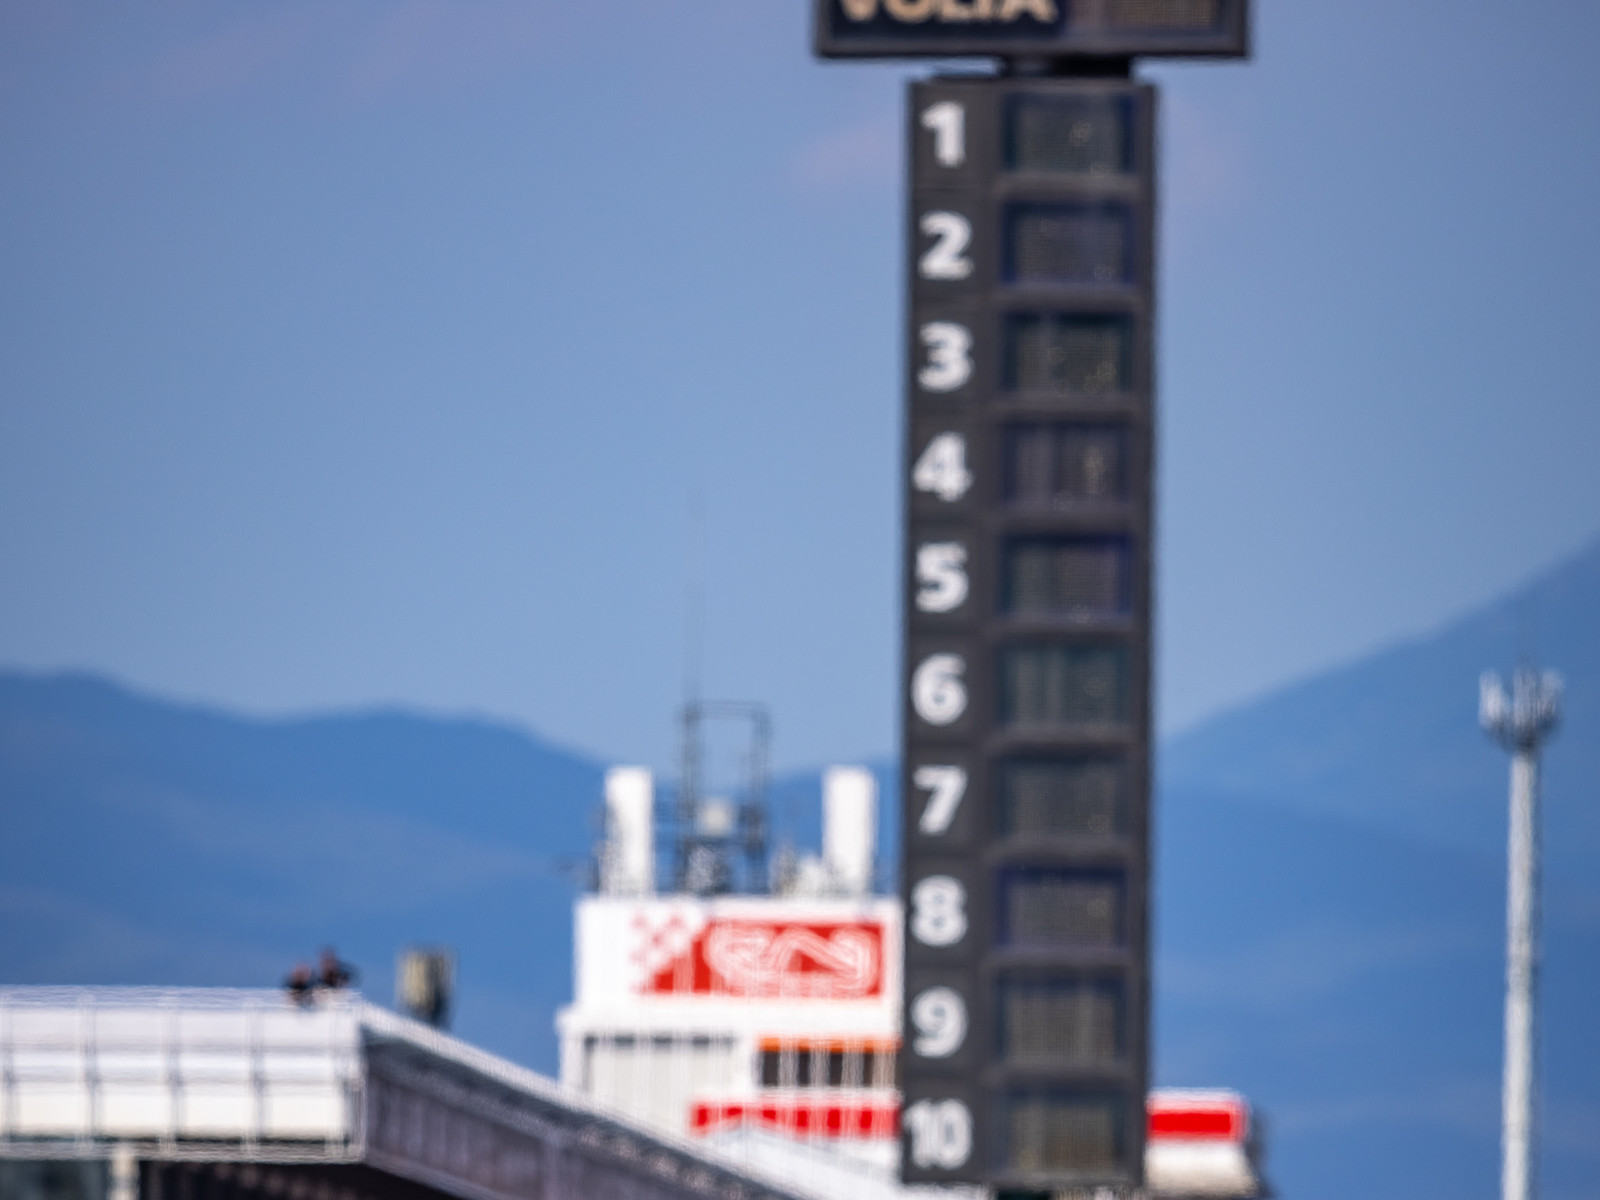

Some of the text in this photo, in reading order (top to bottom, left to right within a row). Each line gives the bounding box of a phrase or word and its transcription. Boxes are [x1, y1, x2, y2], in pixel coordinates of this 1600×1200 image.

[923, 102, 965, 166] 1
[921, 212, 971, 279] 2
[920, 322, 972, 391] 3
[914, 433, 971, 502] 4
[917, 543, 969, 614] 5
[912, 654, 967, 726] 6
[915, 765, 968, 835] 7
[912, 875, 968, 947] 8
[912, 987, 968, 1058] 9
[905, 1099, 973, 1169] 10
